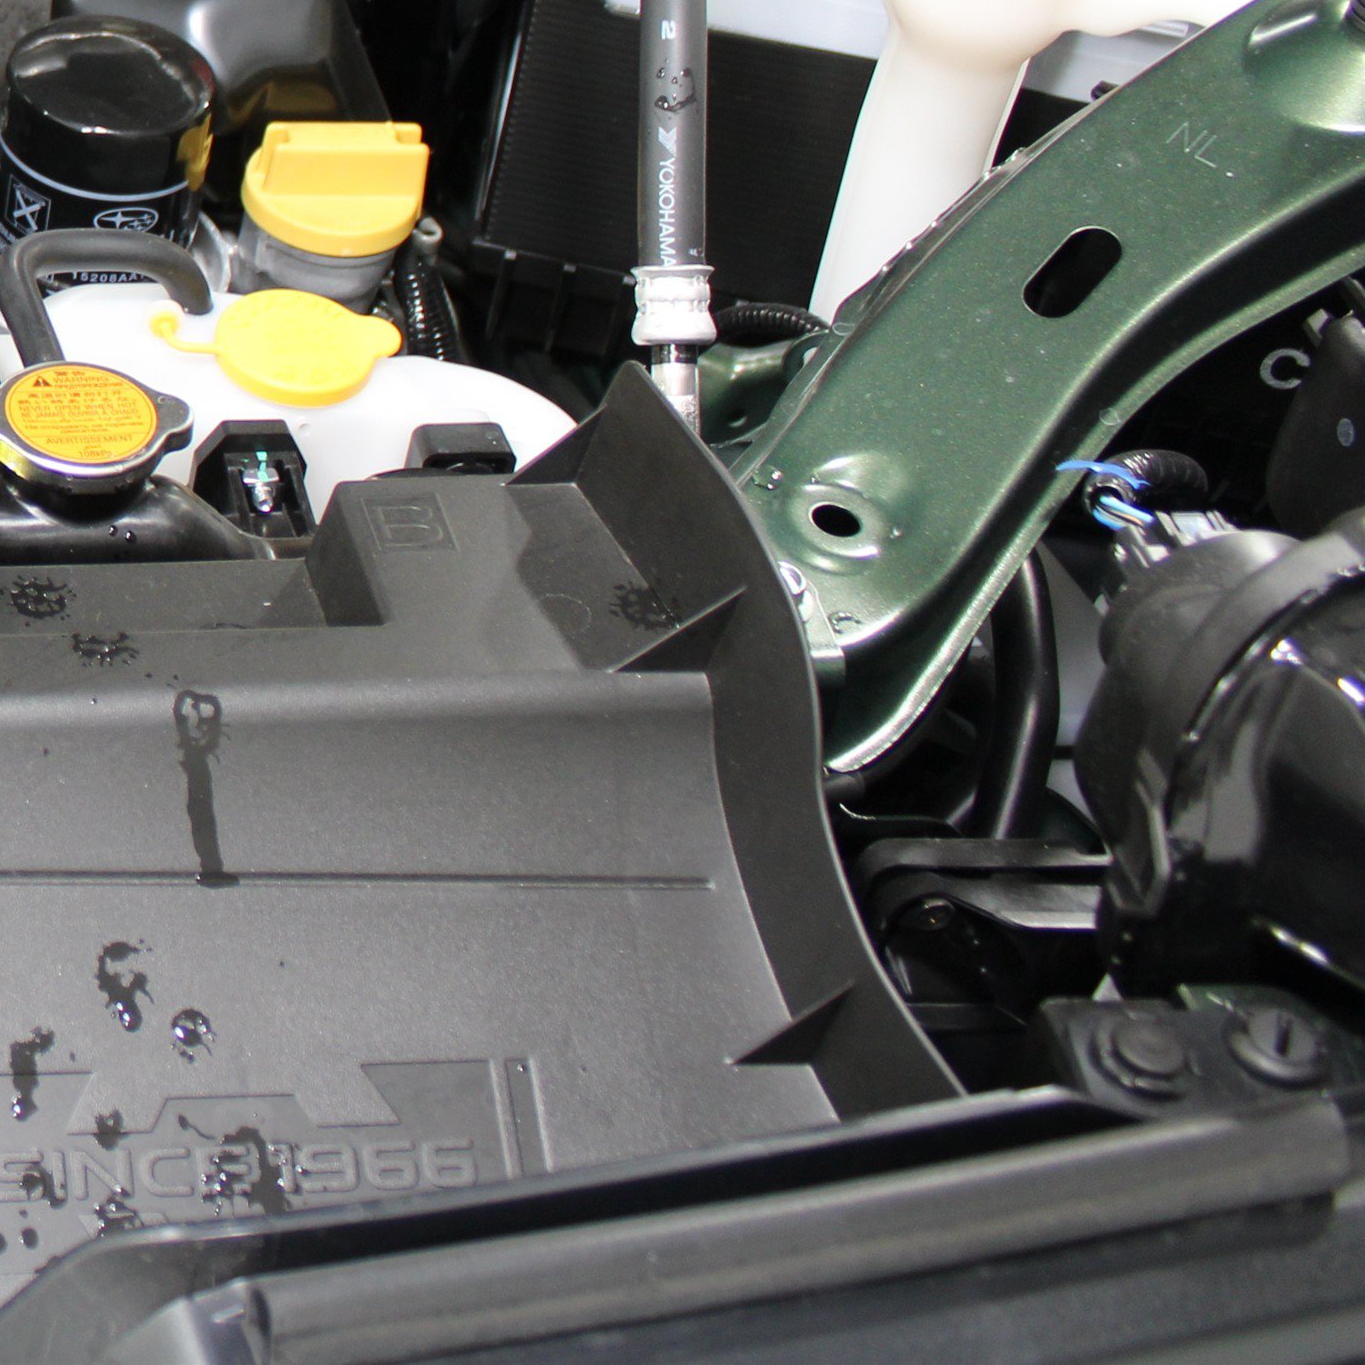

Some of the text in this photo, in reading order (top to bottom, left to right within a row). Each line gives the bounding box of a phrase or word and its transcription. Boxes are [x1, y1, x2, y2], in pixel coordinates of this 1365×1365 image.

[659, 18, 677, 41] 2
[657, 156, 678, 269] YOKOHAMA
[372, 505, 445, 551] B
[267, 1138, 479, 1194] 1966
